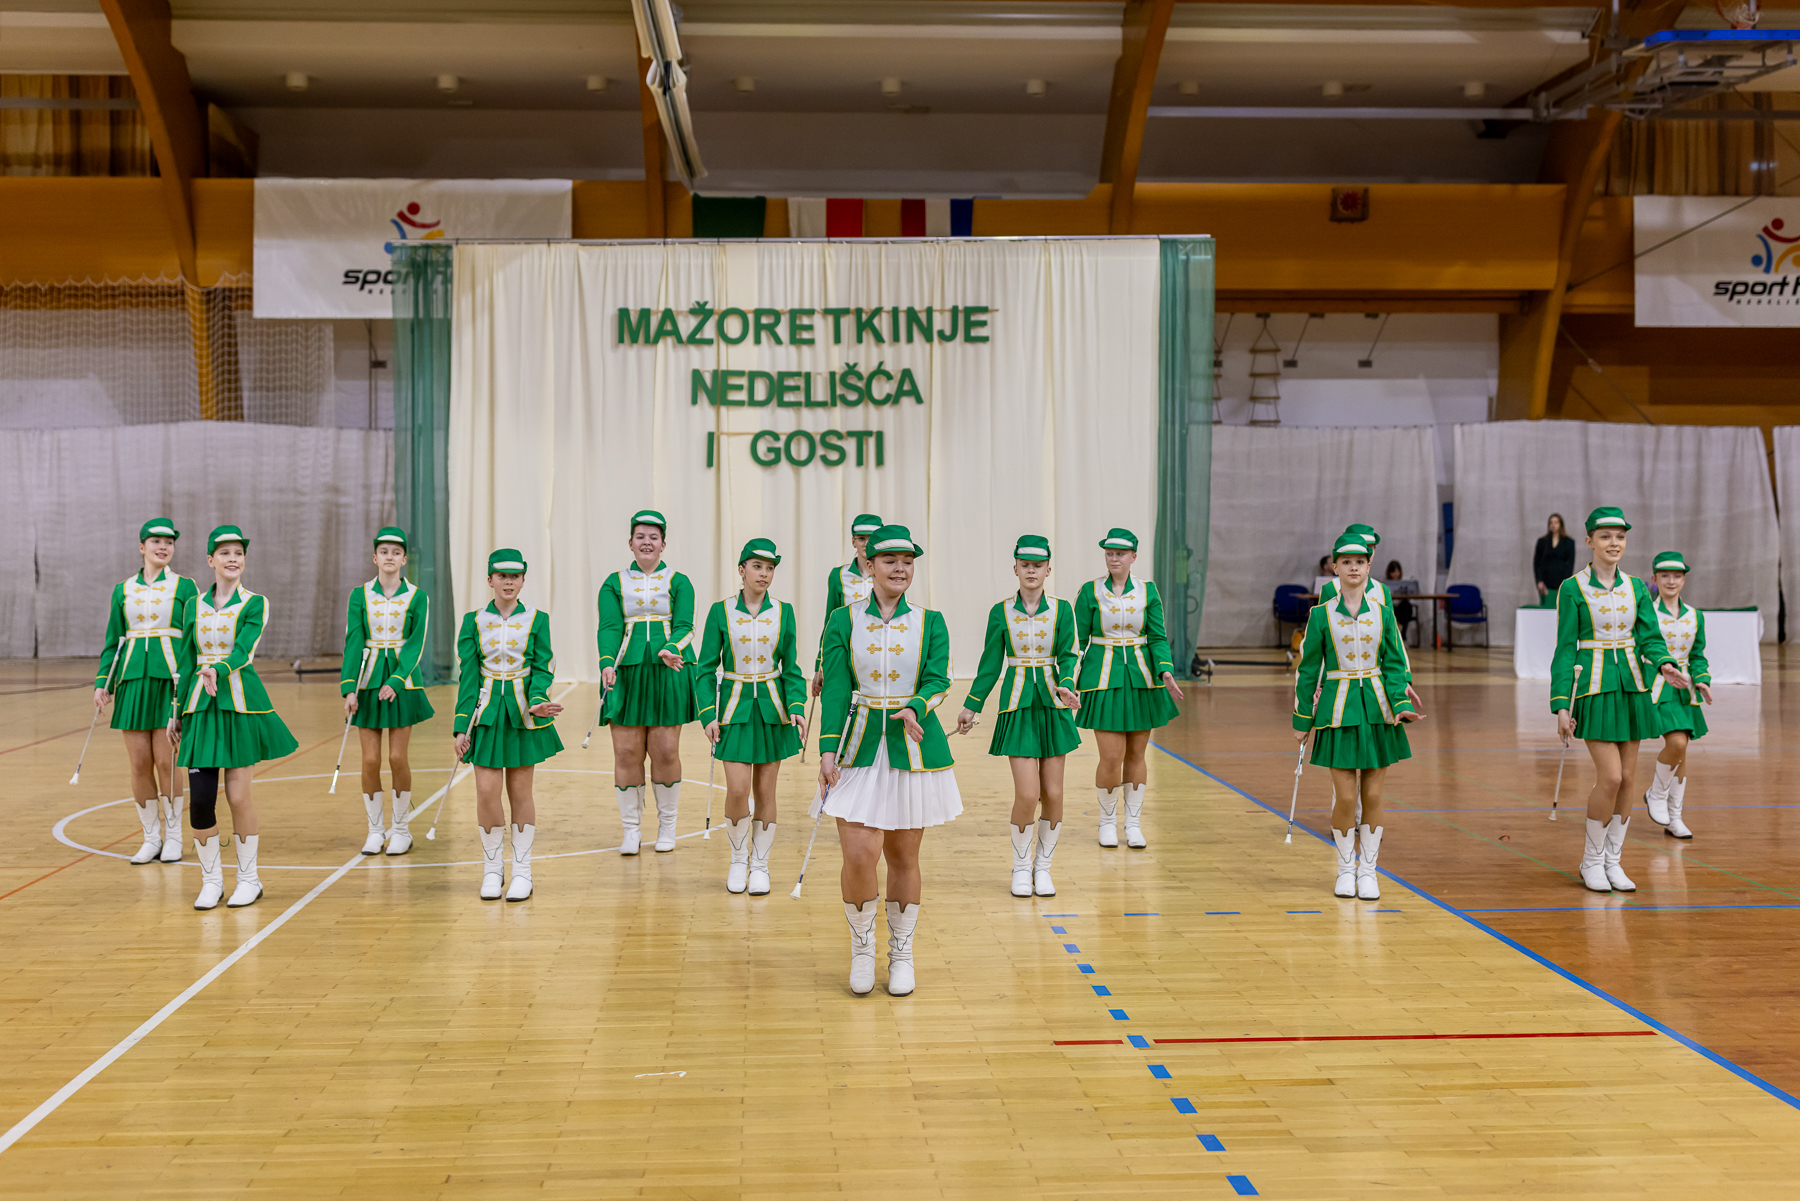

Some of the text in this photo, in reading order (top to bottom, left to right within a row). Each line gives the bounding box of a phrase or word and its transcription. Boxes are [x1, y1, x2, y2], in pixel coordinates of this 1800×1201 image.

[1713, 274, 1790, 303] sport
[617, 301, 990, 345] MAŽORETKINJE
[691, 361, 924, 407] NEDELIŠĆA
[706, 430, 884, 468] I GOSTI
